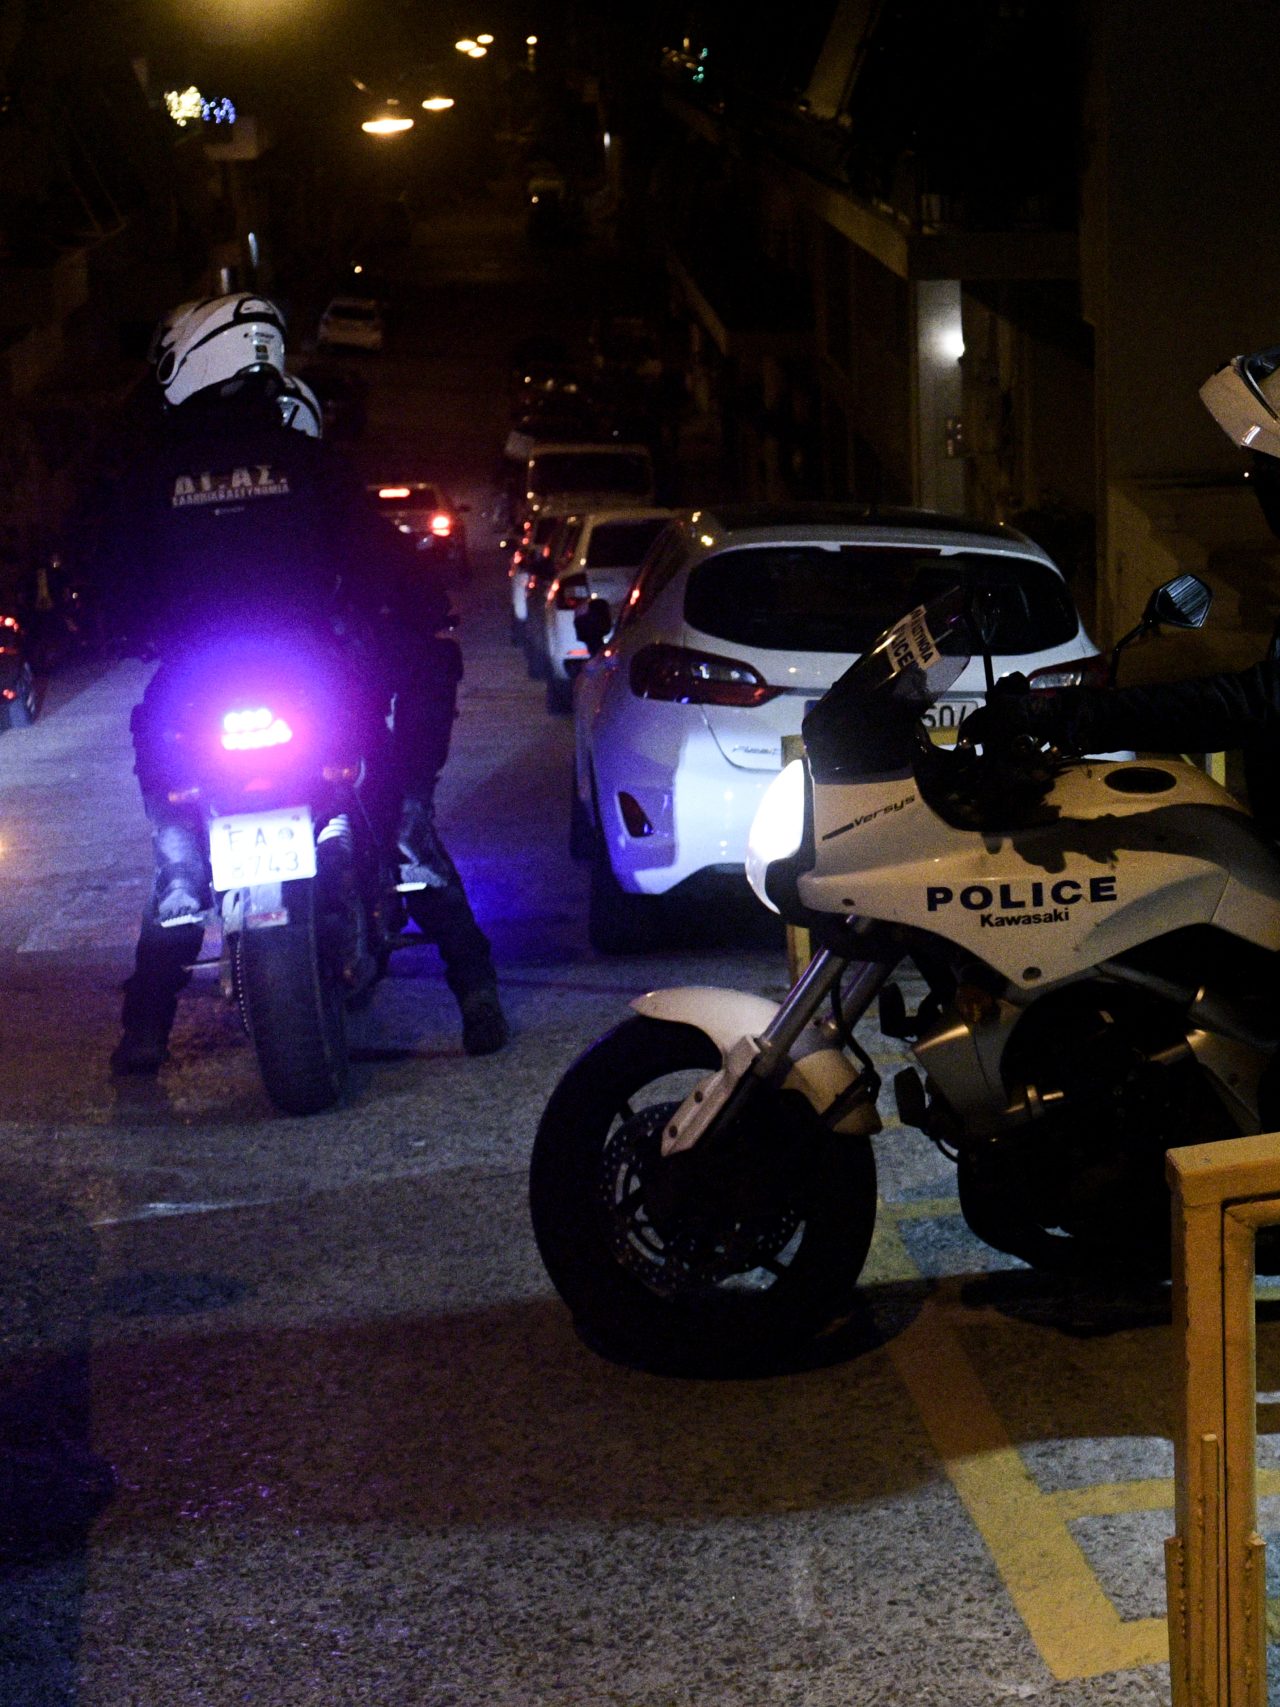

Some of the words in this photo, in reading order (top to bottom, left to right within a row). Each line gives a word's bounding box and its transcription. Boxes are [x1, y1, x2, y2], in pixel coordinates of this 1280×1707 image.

[854, 794, 916, 827] Versys
[927, 876, 1117, 911] POLICE
[980, 907, 1070, 928] Kawasaki
